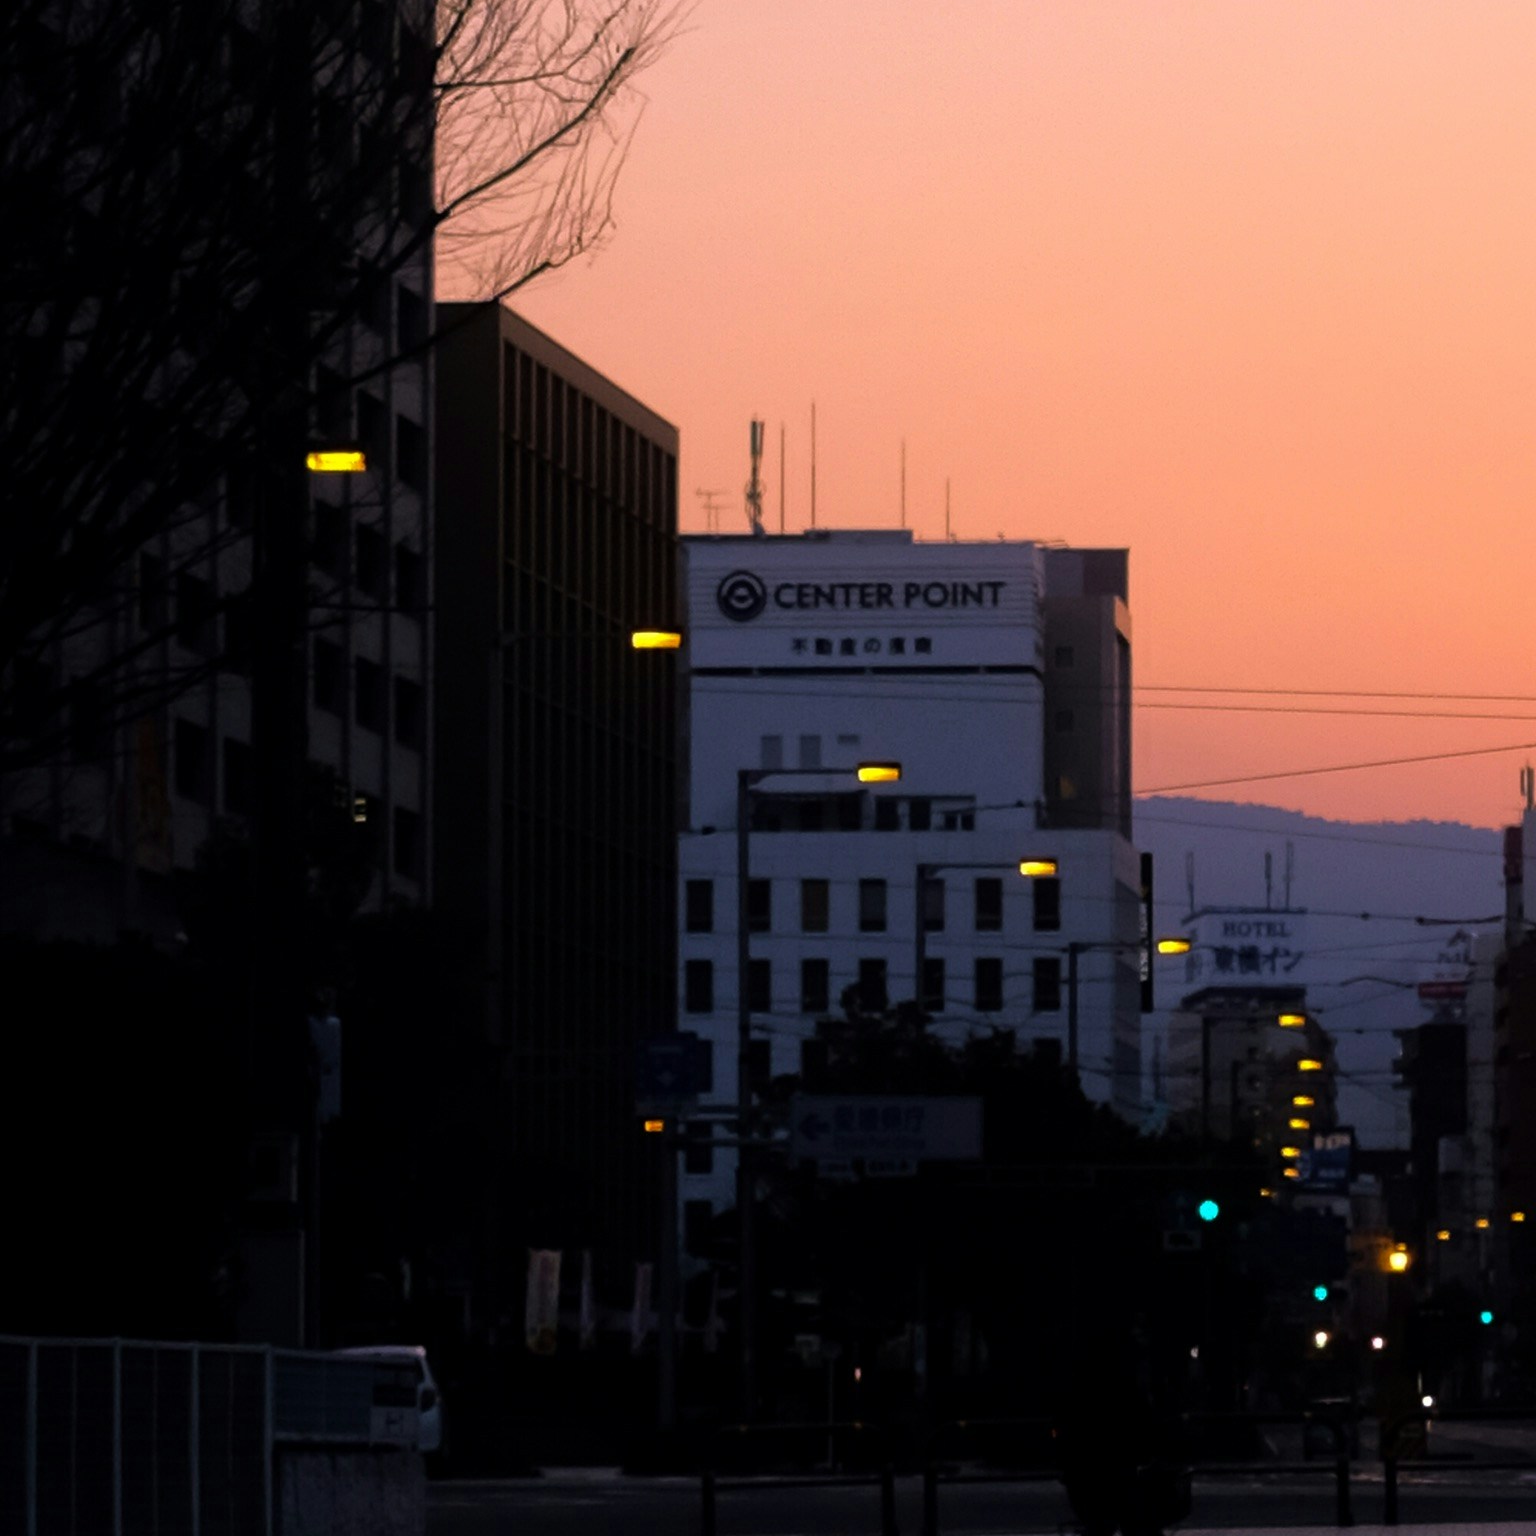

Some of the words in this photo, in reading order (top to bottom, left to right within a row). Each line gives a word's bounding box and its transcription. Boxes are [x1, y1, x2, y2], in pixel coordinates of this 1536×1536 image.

[774, 582, 894, 609] CENTER
[905, 581, 1004, 608] POINT
[1223, 922, 1291, 937] HOTEL
